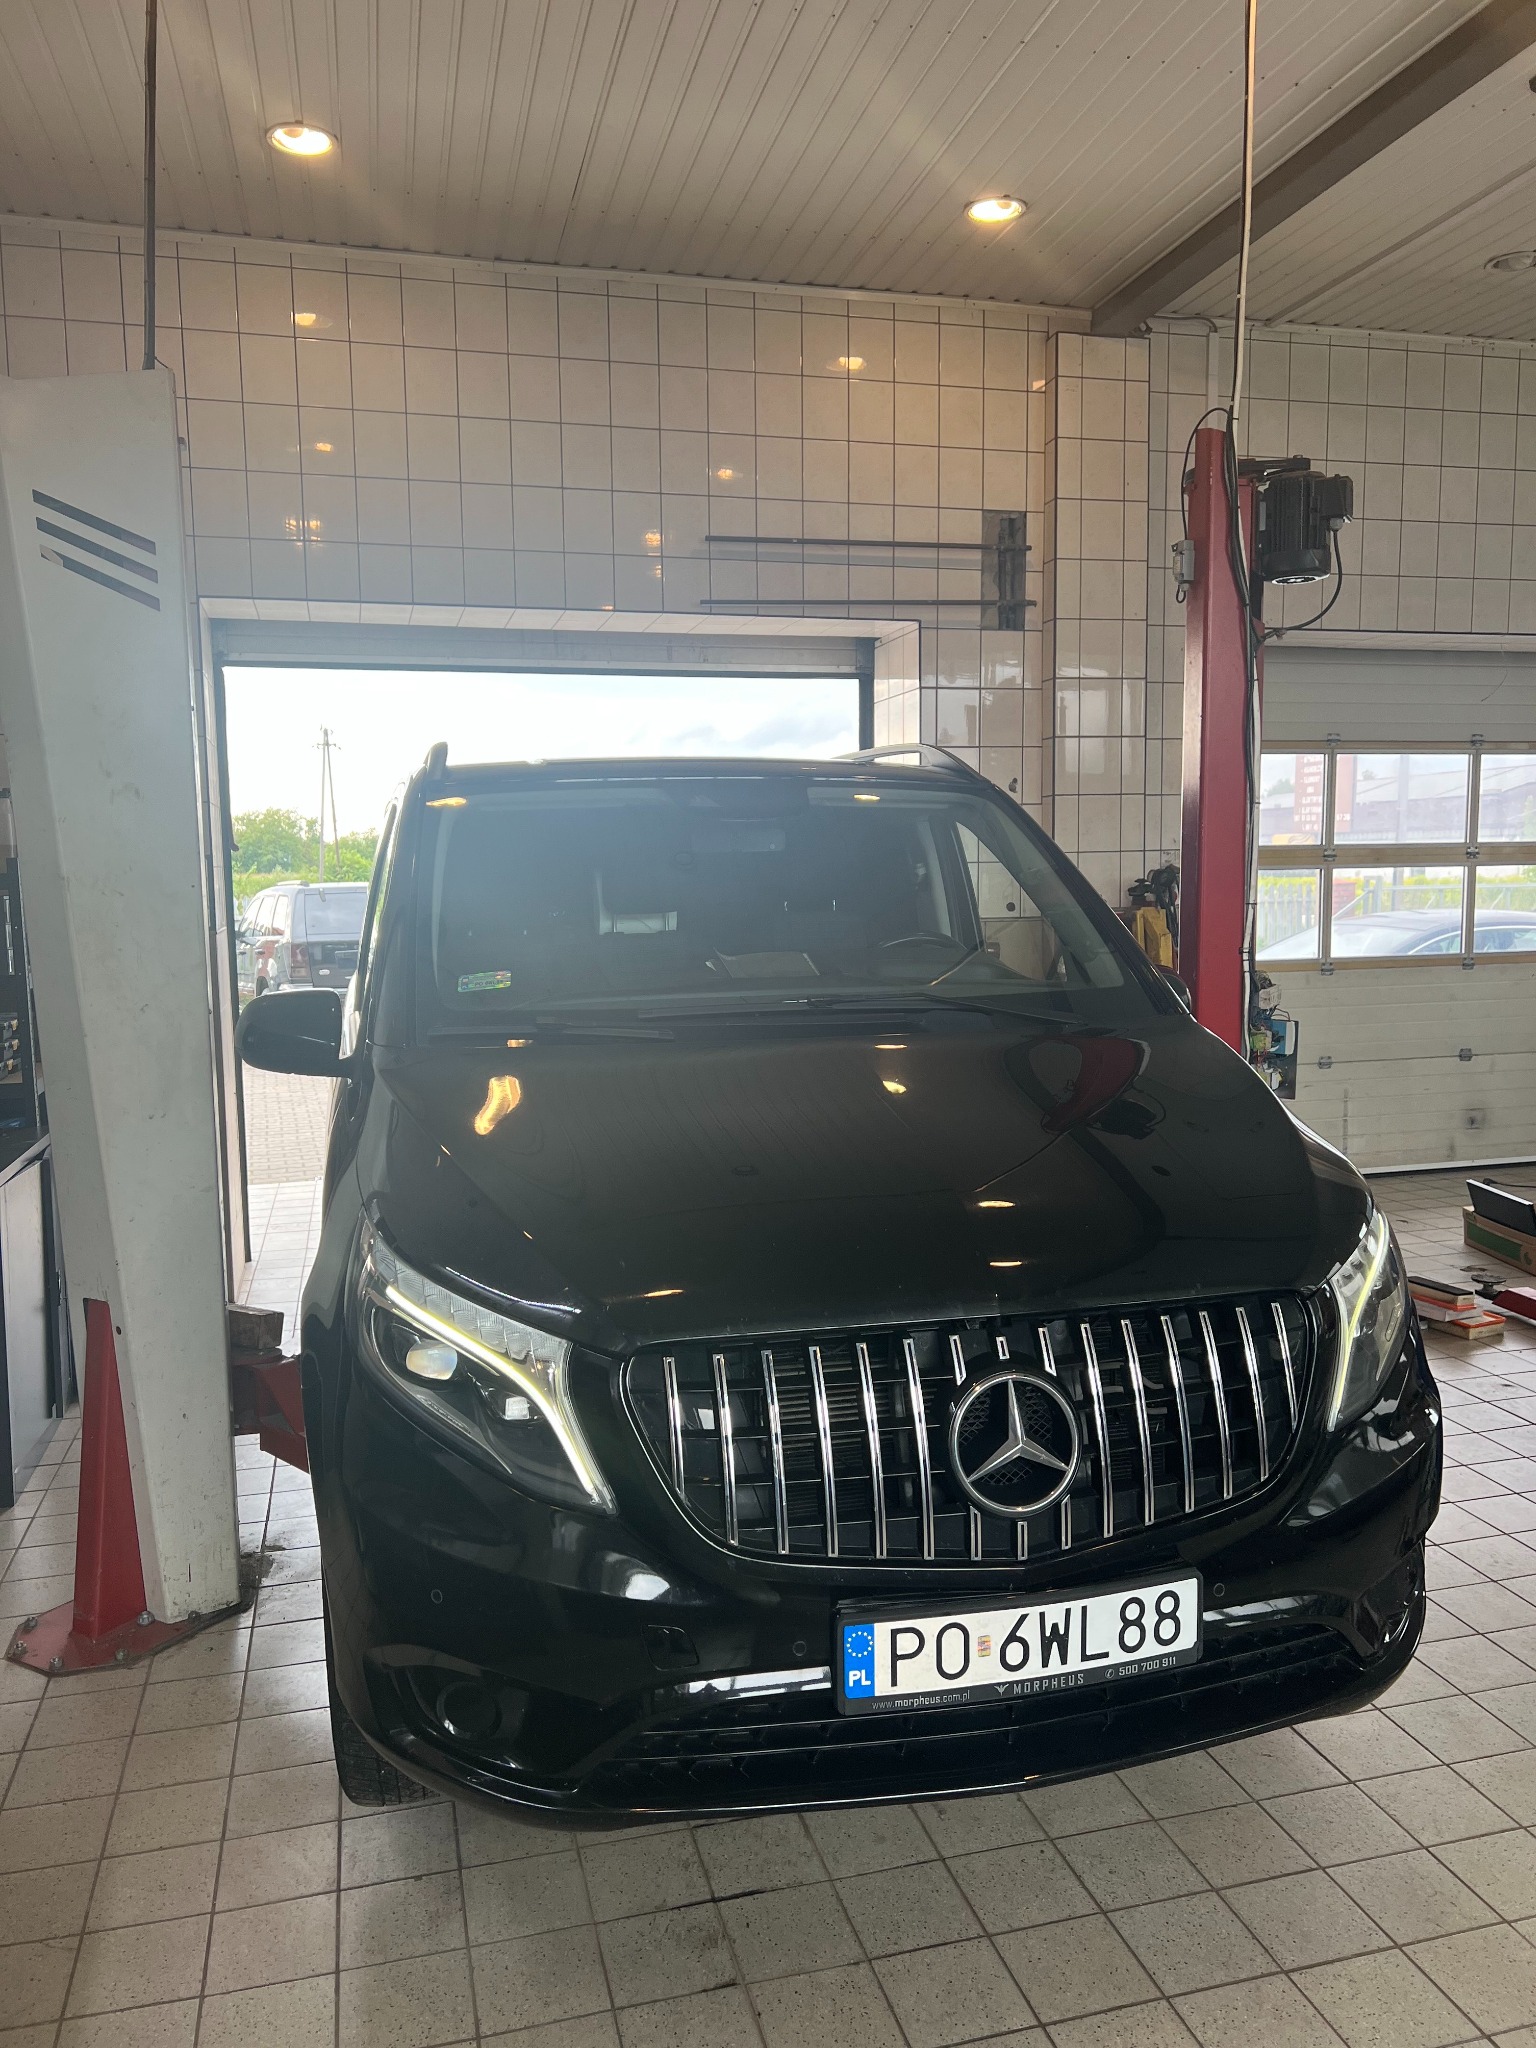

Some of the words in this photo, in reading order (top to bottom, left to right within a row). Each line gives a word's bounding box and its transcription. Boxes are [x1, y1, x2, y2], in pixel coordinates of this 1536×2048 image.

[890, 1621, 970, 1687] PO
[1000, 1590, 1181, 1672] 6WL88
[1118, 1664, 1139, 1676] 500
[1140, 1659, 1160, 1671] 700
[1162, 1656, 1176, 1667] 911
[848, 1669, 872, 1687] PL
[1013, 1673, 1085, 1695] MORPHEUS
[871, 1690, 970, 1710] www.morpheus.com.pl
